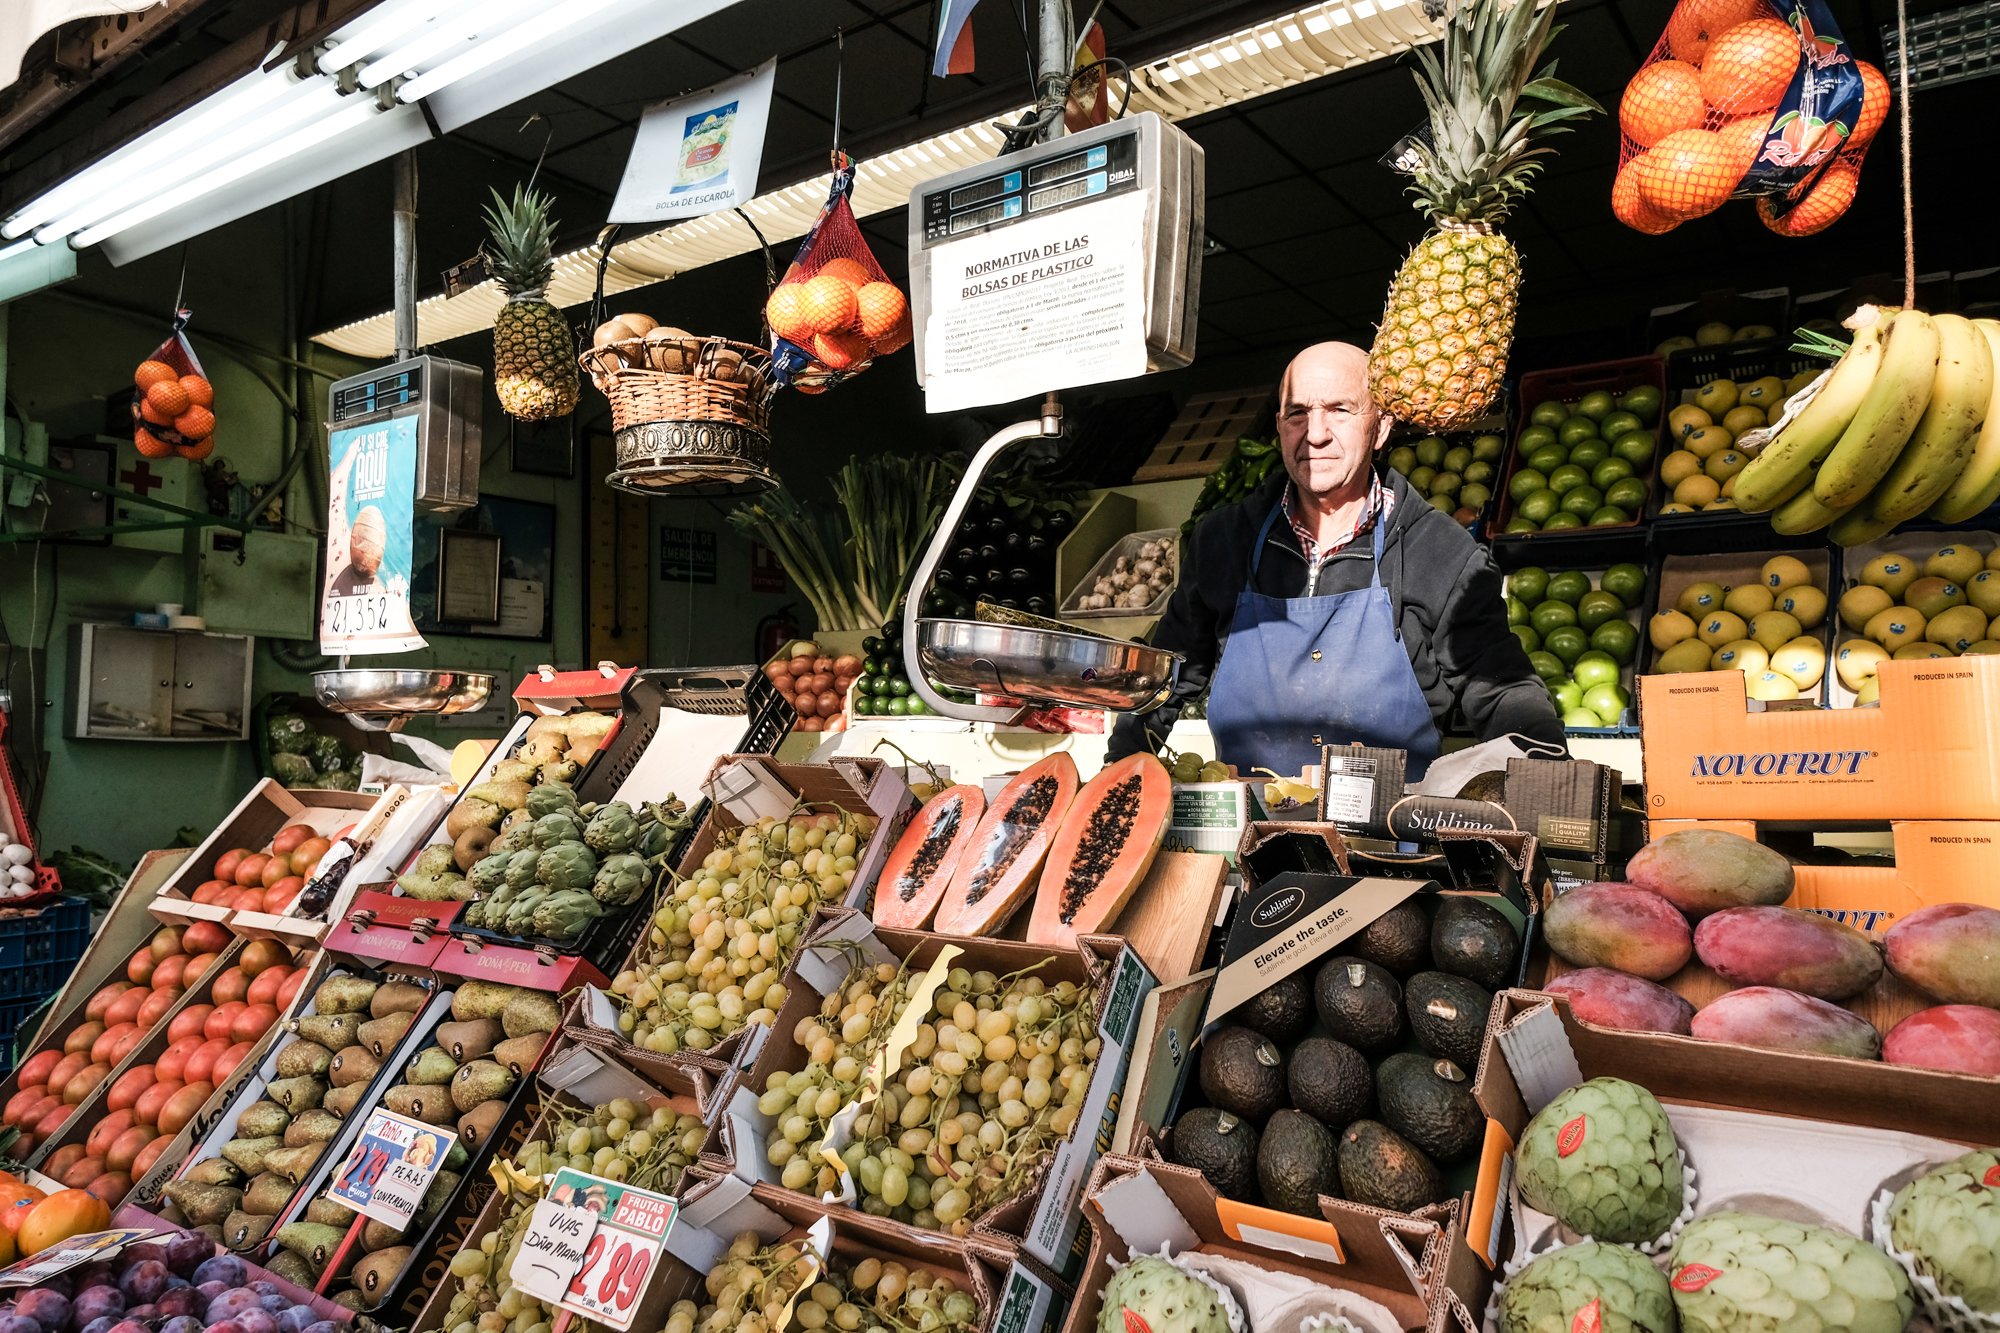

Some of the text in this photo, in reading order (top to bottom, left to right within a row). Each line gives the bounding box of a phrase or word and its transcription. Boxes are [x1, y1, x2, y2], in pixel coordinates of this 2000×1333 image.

[1109, 168, 1135, 182] DIBAL
[656, 189, 735, 210] BOLSA DE ESCAROLA
[965, 235, 1089, 277] NORMATIVA DE LAS
[962, 254, 1093, 298] BOLSAS DE PLASTICO
[368, 433, 375, 451] SI
[375, 430, 388, 450] CAE
[663, 528, 713, 546] SALIDA DE
[662, 545, 715, 563] EMERGENCIA
[1914, 672, 1945, 681] PRODUCED
[1946, 672, 1954, 680] IN
[1690, 750, 1872, 777] NOVOFRUT
[1559, 823, 1590, 831] PREMIUM
[1259, 892, 1296, 920] Sublime
[361, 934, 408, 951] DOÑA PERA
[1253, 939, 1296, 969] Elevate
[1296, 924, 1316, 942] the
[1316, 907, 1349, 931] taste.
[1259, 958, 1287, 978] Sublime
[1309, 933, 1328, 946] Eleva
[1328, 927, 1334, 935] el
[1334, 916, 1353, 933] gusto
[477, 954, 532, 974] DOÑA PERA
[378, 1120, 402, 1141] Pablo
[392, 1165, 426, 1187] PERAS
[373, 1189, 415, 1216] CONFERENCIA
[401, 1103, 542, 1317] DOÑA ERA
[627, 1195, 665, 1214] FRUTAS
[616, 1207, 664, 1233] PABLO
[550, 1241, 583, 1263] MARIA
